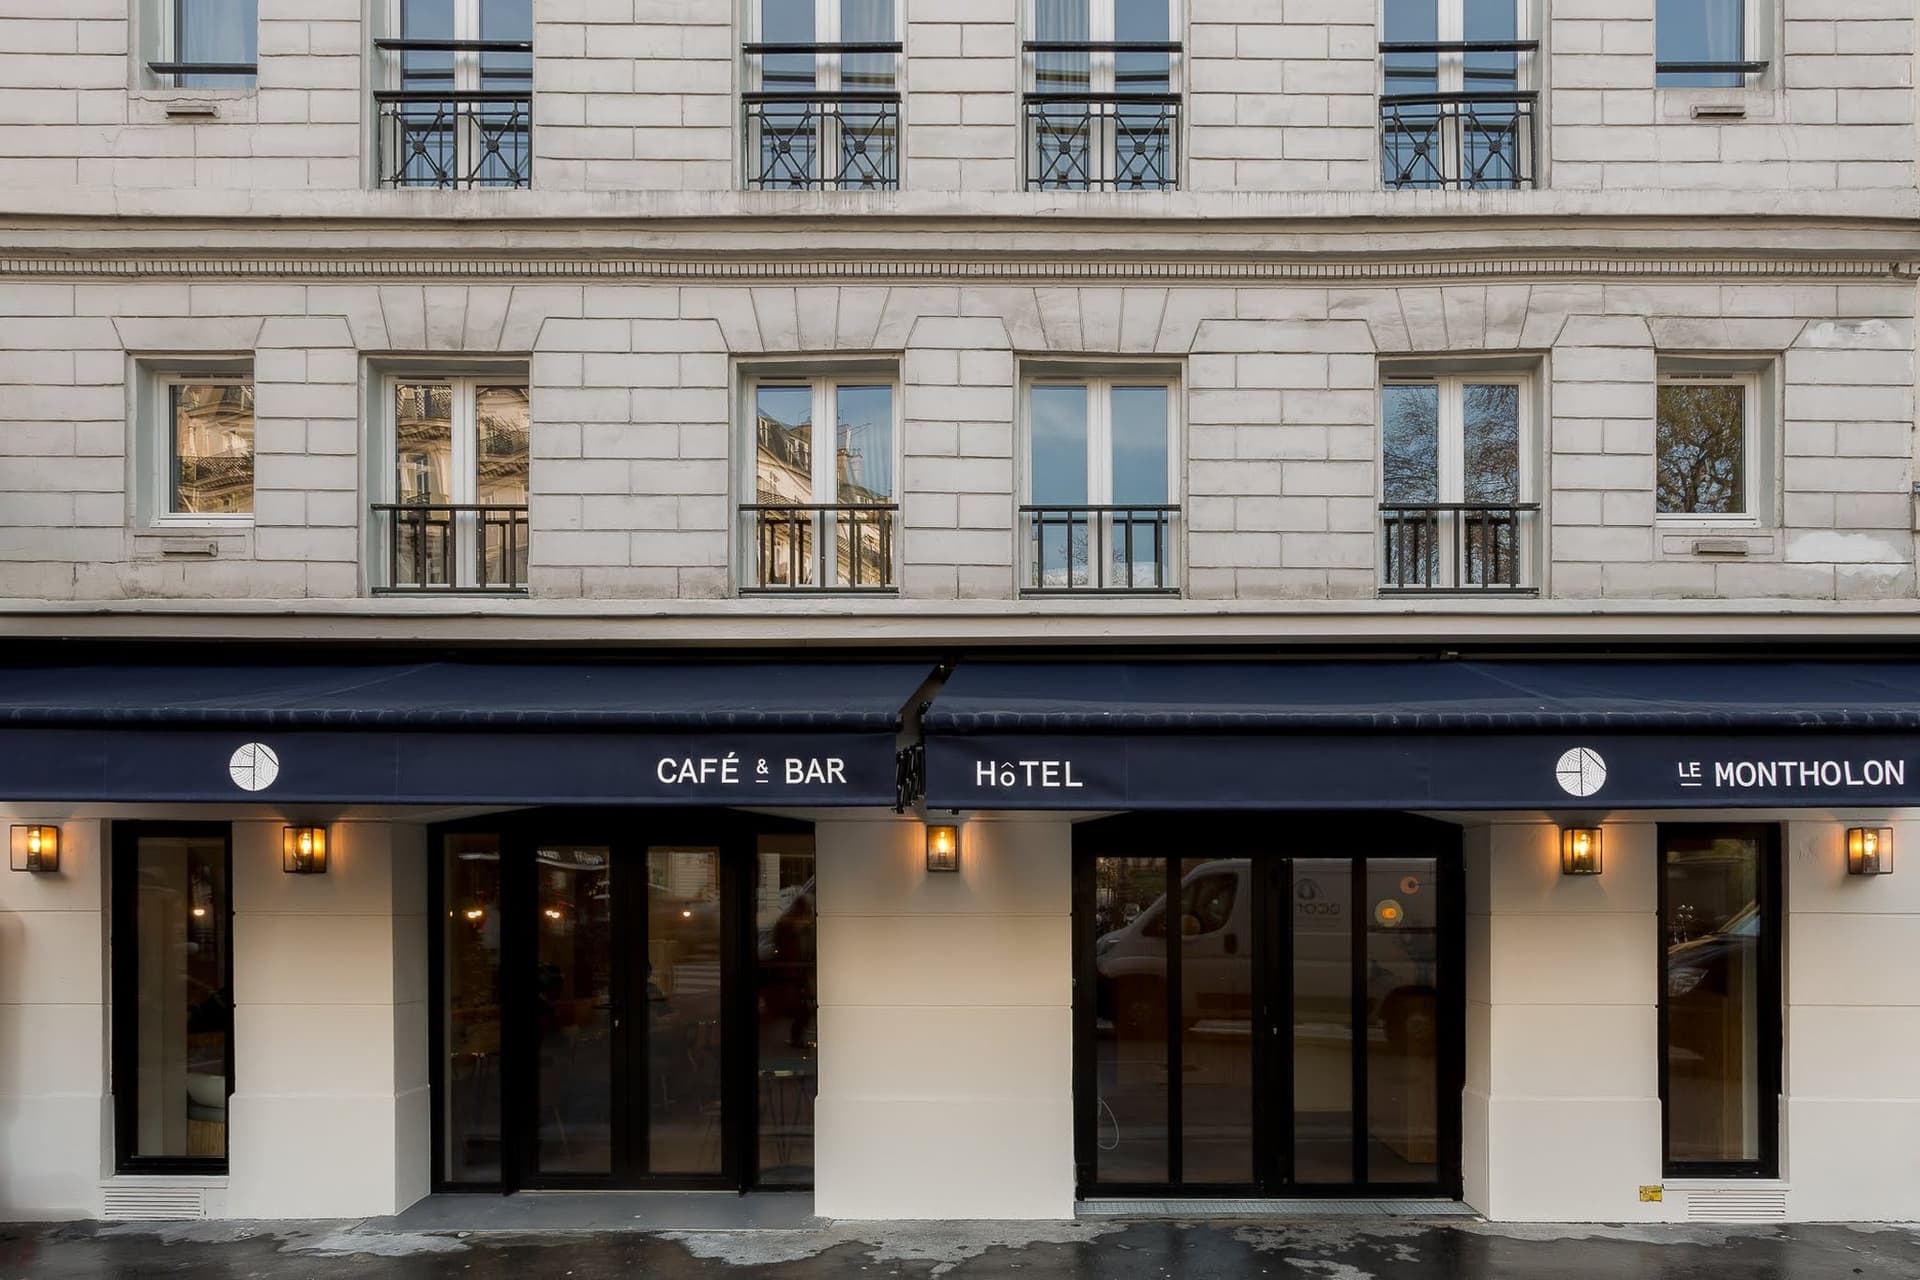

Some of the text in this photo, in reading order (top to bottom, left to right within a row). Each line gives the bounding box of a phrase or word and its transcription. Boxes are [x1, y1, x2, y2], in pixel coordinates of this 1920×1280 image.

[656, 752, 847, 785] CAFÉ & BAR
[1678, 759, 1905, 788] LE MONTHOLON
